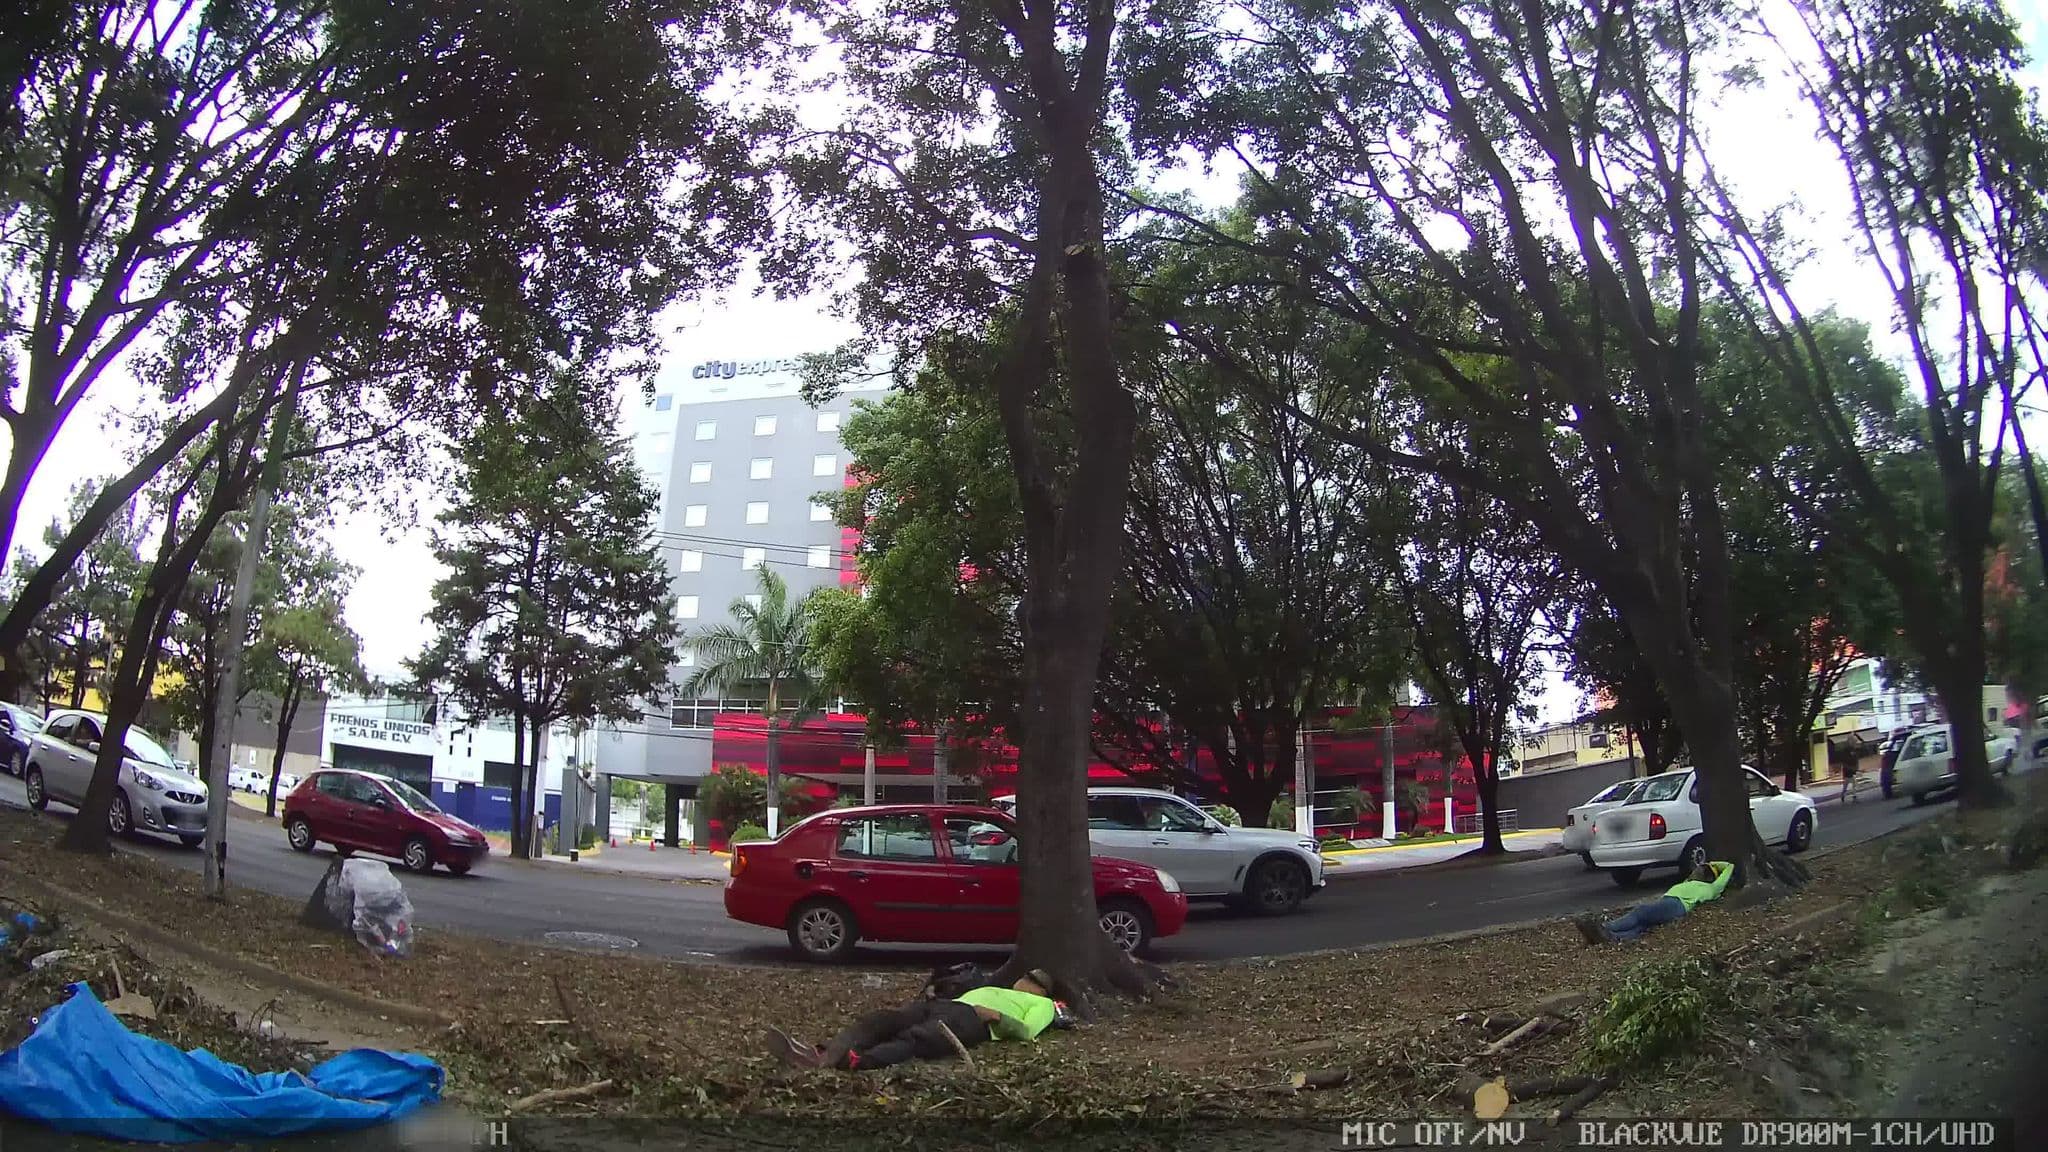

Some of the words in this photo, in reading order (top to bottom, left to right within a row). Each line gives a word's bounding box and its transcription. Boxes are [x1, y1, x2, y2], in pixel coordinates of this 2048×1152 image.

[330, 713, 378, 729] FRENOS
[384, 721, 431, 736] UNICOS
[370, 730, 387, 740] DE
